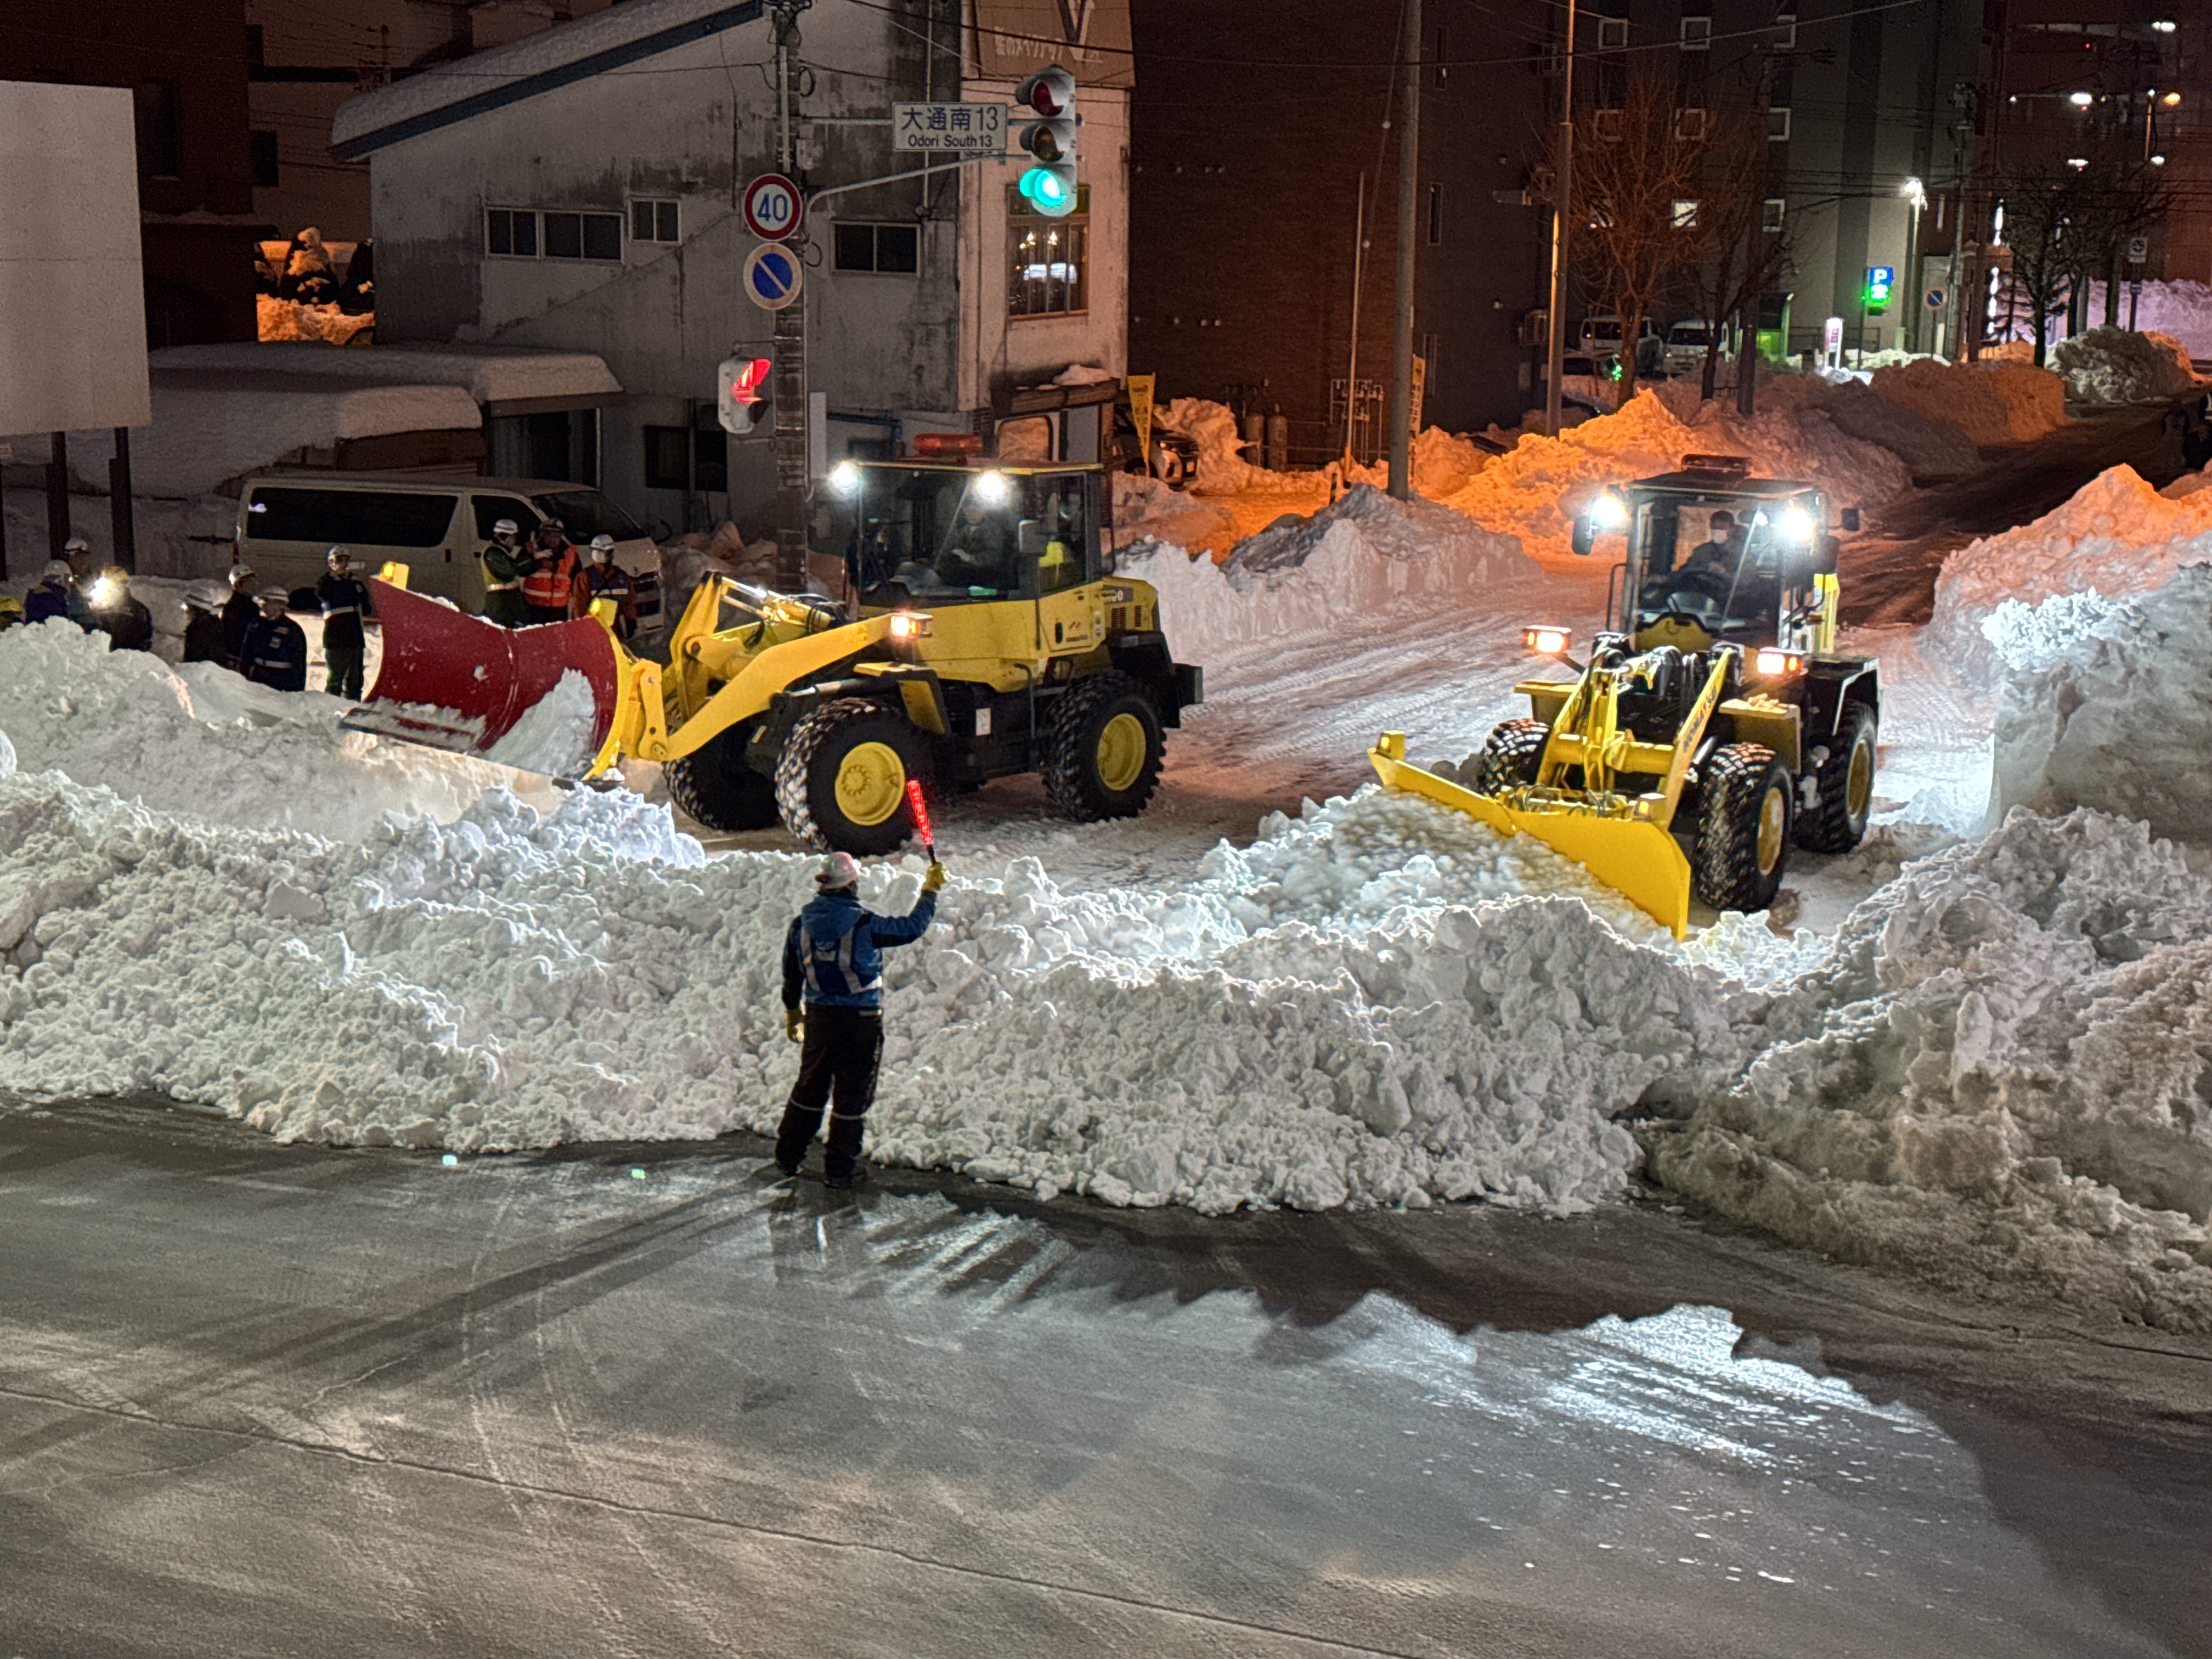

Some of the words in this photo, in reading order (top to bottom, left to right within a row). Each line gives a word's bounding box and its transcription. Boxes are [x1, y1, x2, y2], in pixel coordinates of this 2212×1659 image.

[901, 106, 998, 131] 大通南13
[908, 134, 939, 147] Odori
[758, 194, 788, 222] 40
[1874, 269, 1887, 284] P
